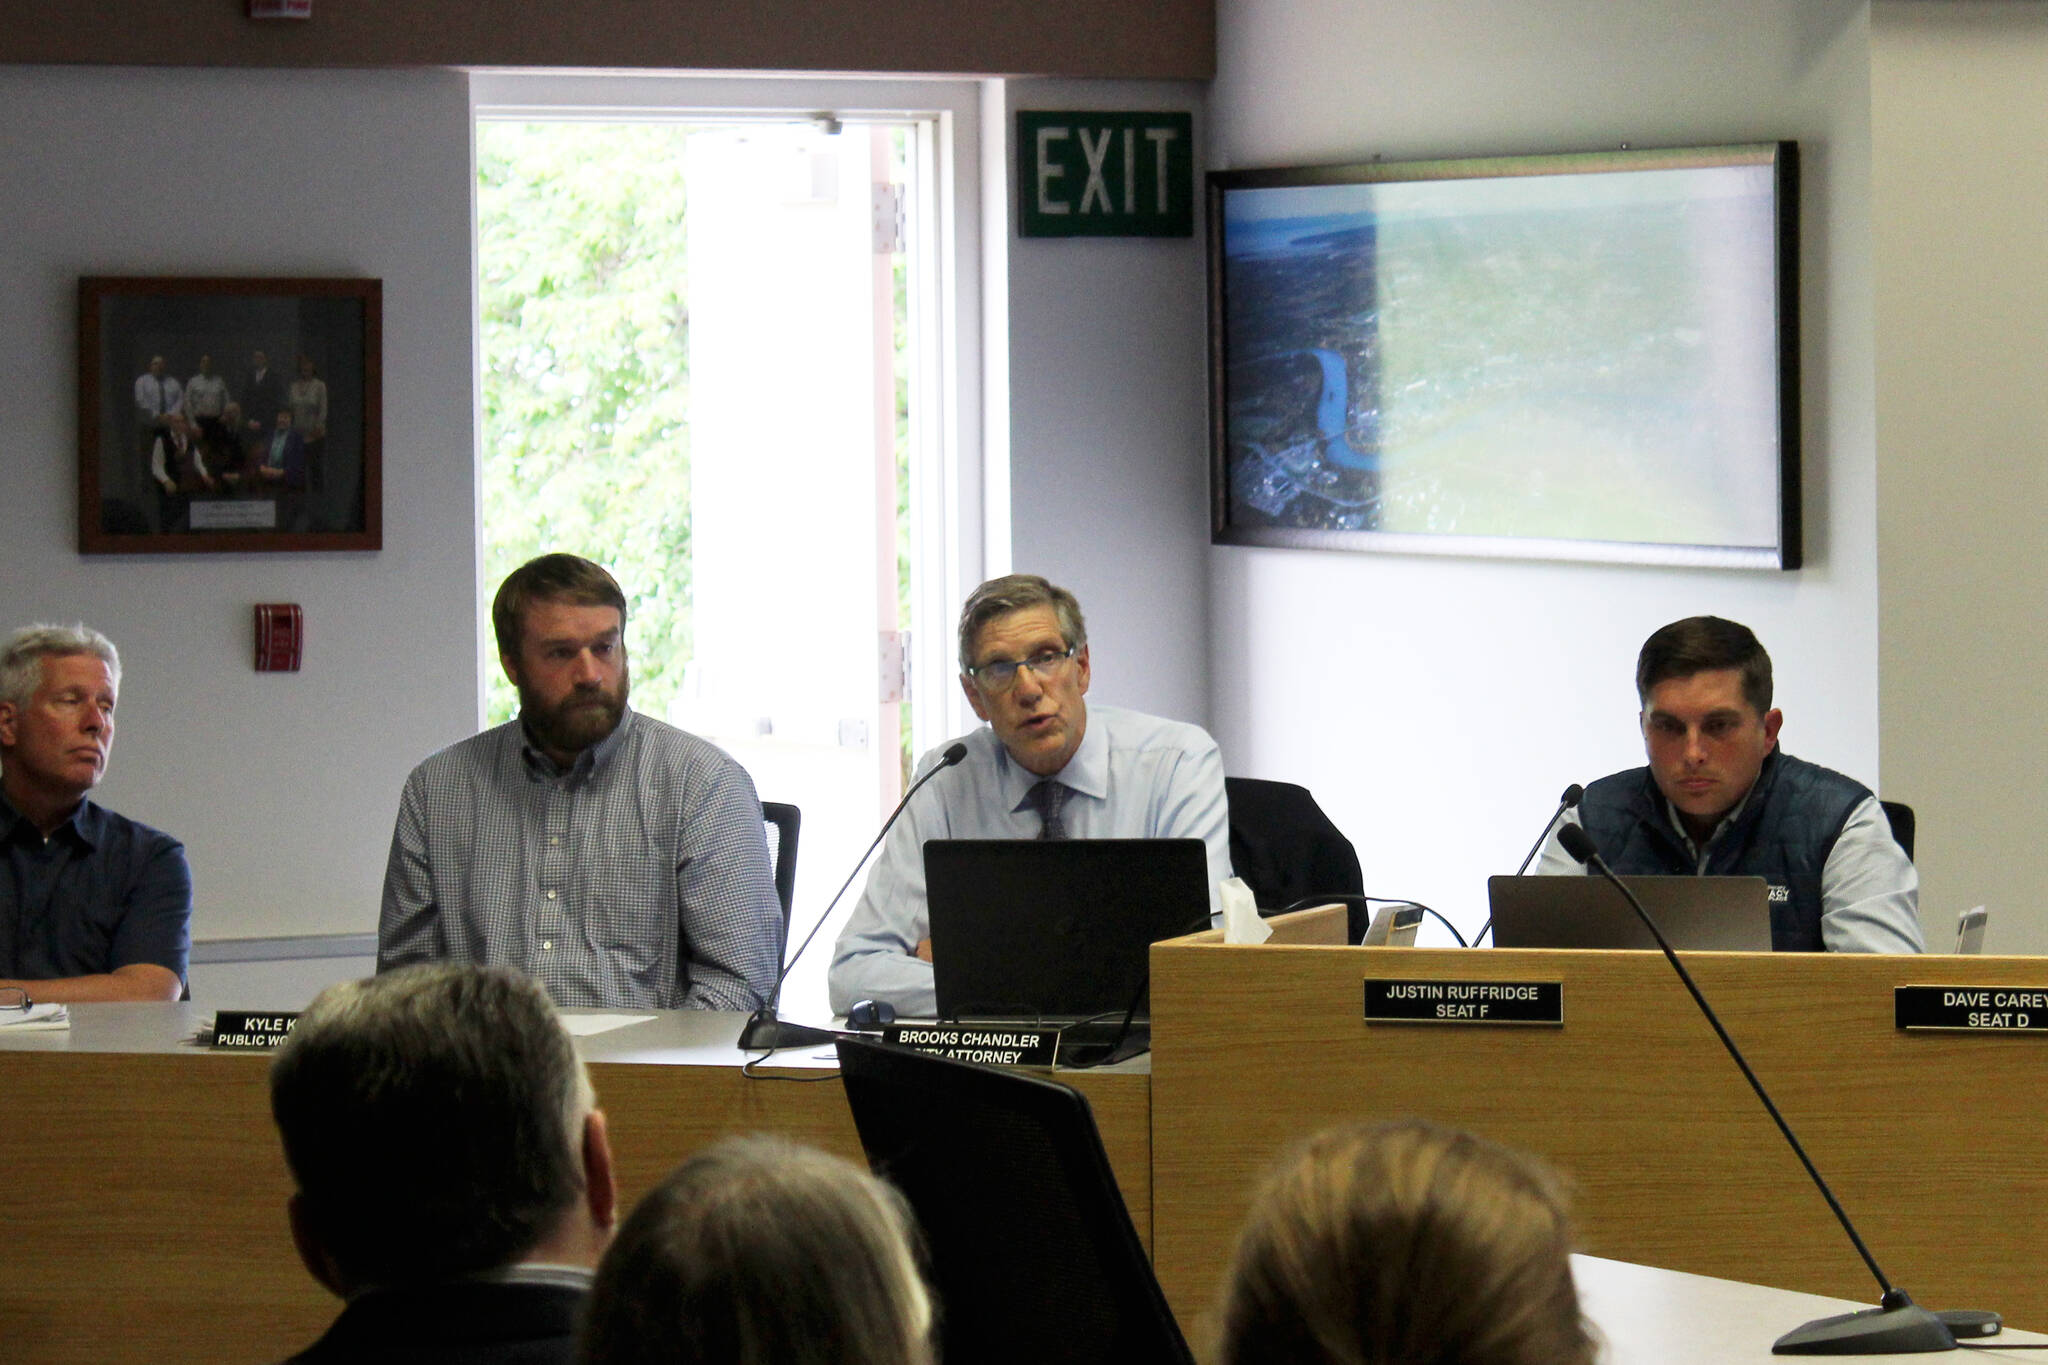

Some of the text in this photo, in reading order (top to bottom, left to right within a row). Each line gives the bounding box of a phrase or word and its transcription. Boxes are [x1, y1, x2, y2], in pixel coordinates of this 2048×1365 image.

[1037, 127, 1178, 214] EXIT
[1386, 985, 1539, 1001] JUSTIN RUFFRIDGE
[1943, 992, 1990, 1007] DAVE
[1436, 1004, 1489, 1018] SEAT F
[244, 1017, 284, 1031] KYLE
[1968, 1012, 2030, 1028] SEAT D
[218, 1034, 265, 1046] PUBLIC
[899, 1030, 1040, 1048] BROOKS CHANDLER
[946, 1049, 1022, 1065] ATTORNEY
